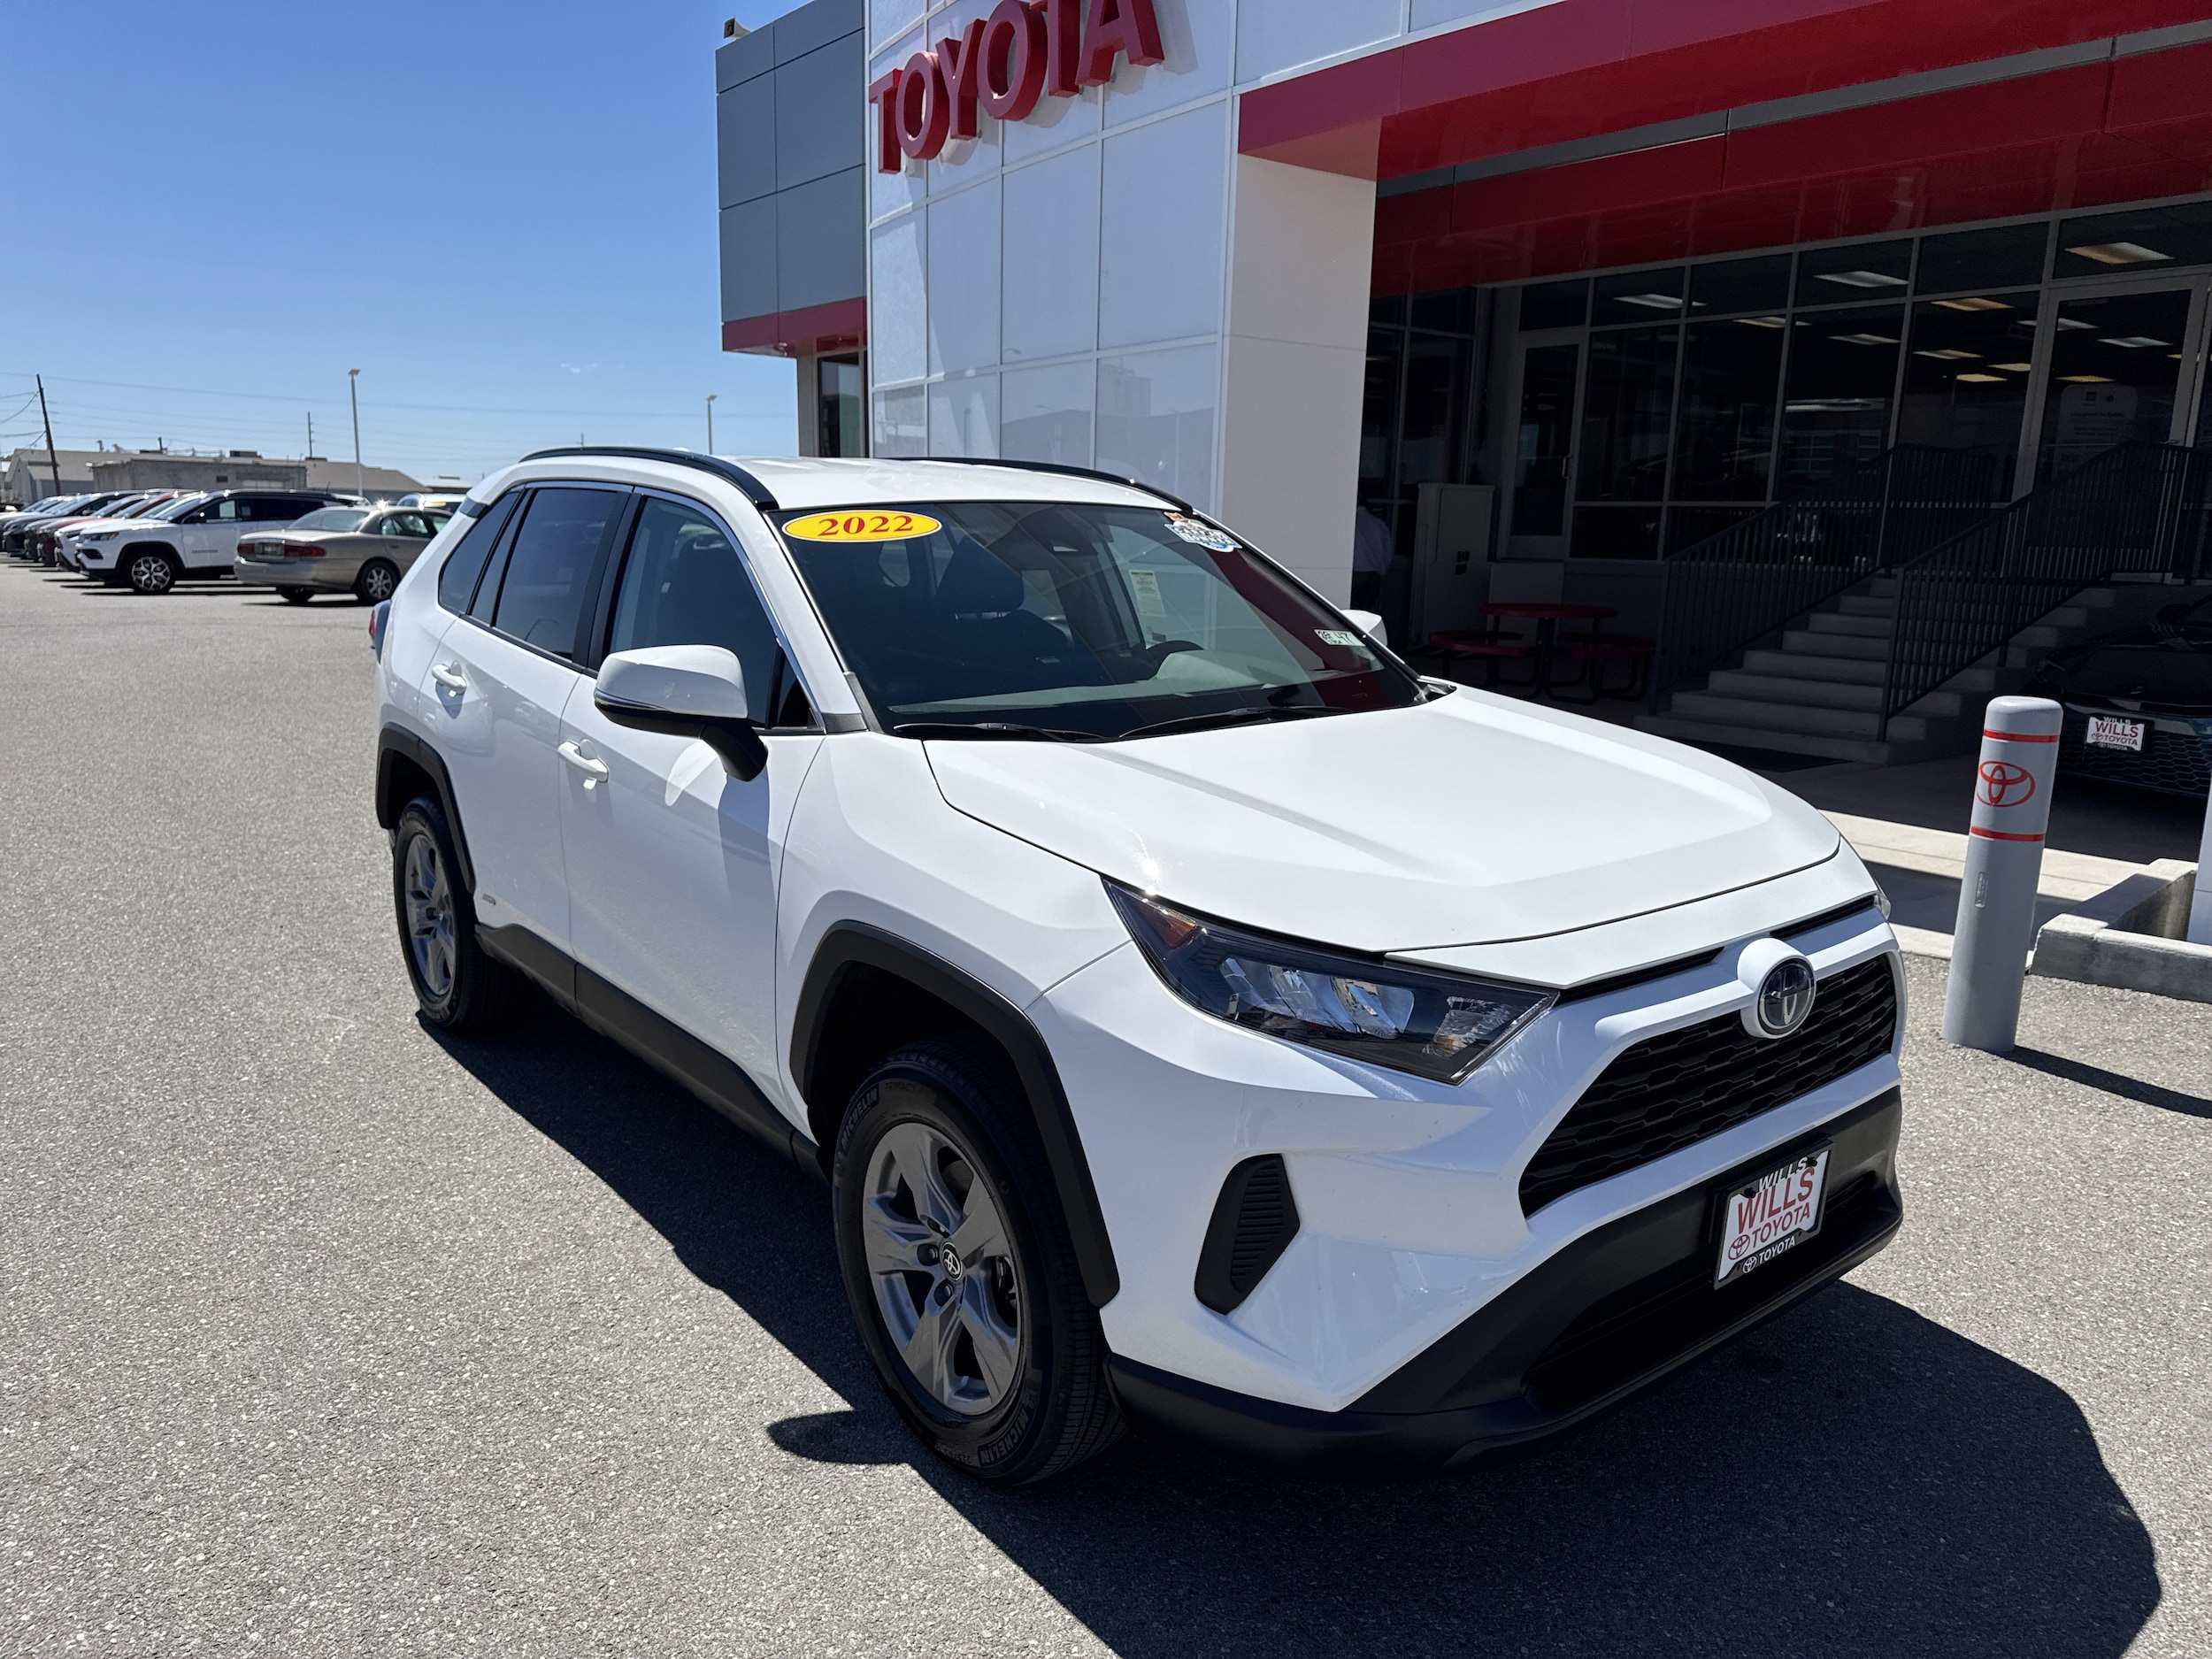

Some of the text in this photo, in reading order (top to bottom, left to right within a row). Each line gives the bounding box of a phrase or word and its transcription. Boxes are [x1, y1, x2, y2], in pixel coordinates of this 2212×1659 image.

[869, 0, 1164, 174] TOYOTA
[818, 515, 914, 536] 2022
[2095, 721, 2139, 738] WILLS
[2104, 734, 2138, 746] TOYOTA
[841, 1087, 879, 1149] MICHELIN
[1758, 1156, 1808, 1192] WILLS
[1738, 1167, 1815, 1234] WILLS
[1753, 1202, 1810, 1248] TOYOTA
[1758, 1235, 1795, 1263] TOYOTA
[979, 1407, 1029, 1463] MICHELIN
